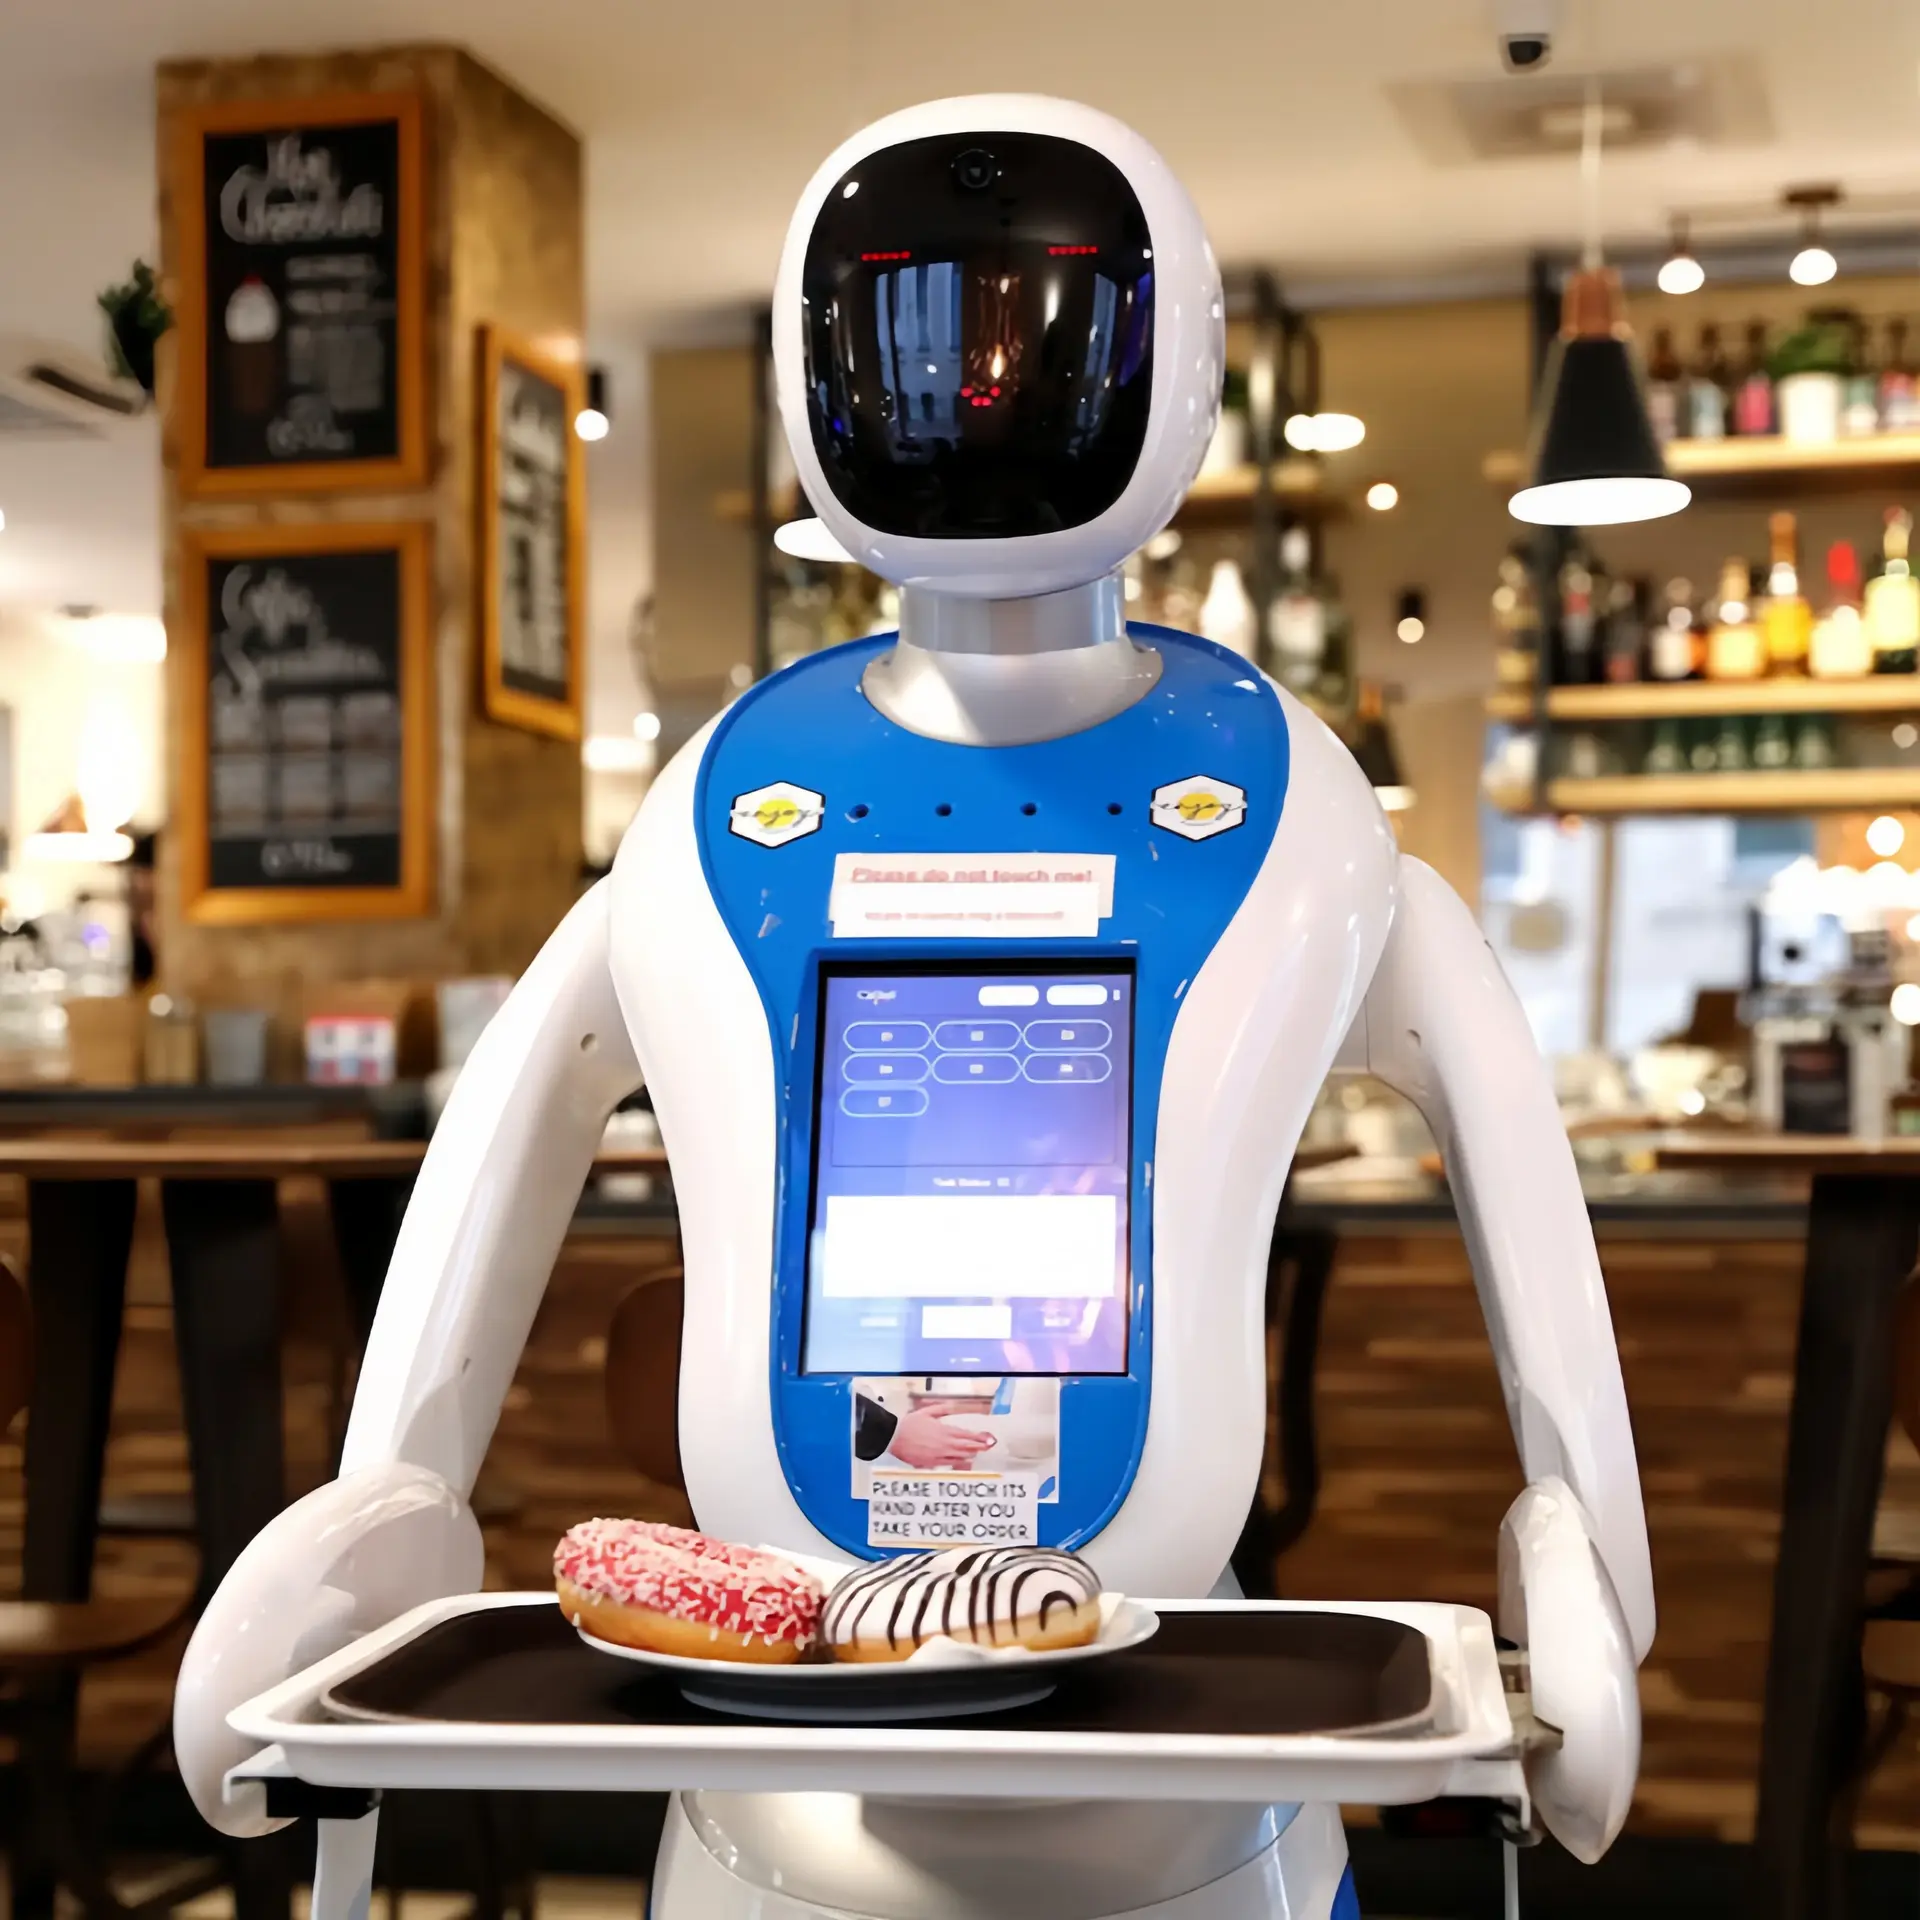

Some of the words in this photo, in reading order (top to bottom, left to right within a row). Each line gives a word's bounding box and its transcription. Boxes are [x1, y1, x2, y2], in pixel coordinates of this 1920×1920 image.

[923, 868, 950, 883] do
[954, 869, 987, 883] not
[992, 869, 1050, 883] touch
[872, 1481, 931, 1497] PLEASE
[938, 1482, 998, 1498] TOUCH
[872, 1501, 916, 1516] HAND
[921, 1502, 970, 1518] AFTER
[976, 1502, 1016, 1518] YOU
[873, 1521, 911, 1537] TAKE
[917, 1522, 967, 1538] YOUR
[972, 1523, 1031, 1540] ORDER
